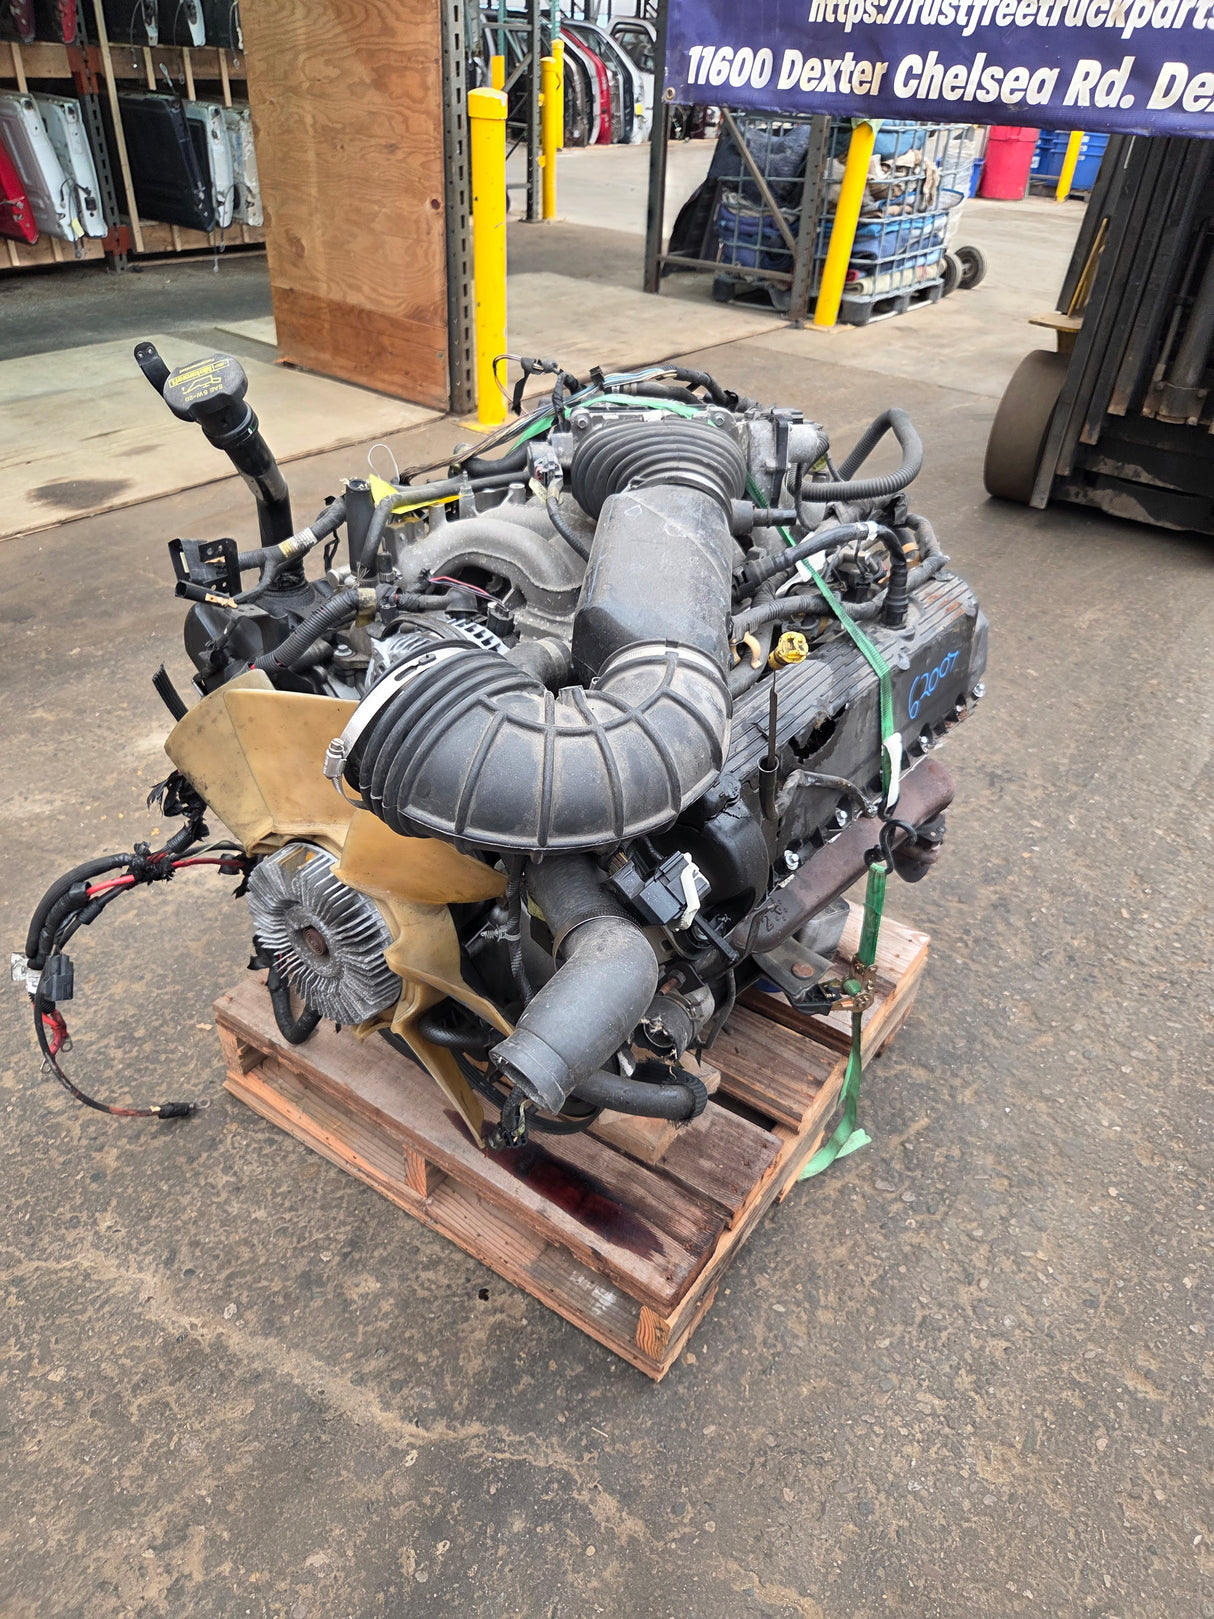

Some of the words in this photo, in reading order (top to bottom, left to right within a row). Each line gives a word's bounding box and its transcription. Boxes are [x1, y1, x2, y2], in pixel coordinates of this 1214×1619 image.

[687, 46, 773, 88] 11600
[777, 49, 888, 96] Dexter
[893, 51, 1060, 104] Chelsea
[1063, 56, 1136, 108] Rd.
[1146, 62, 1214, 112] De
[908, 650, 959, 720] 62007
